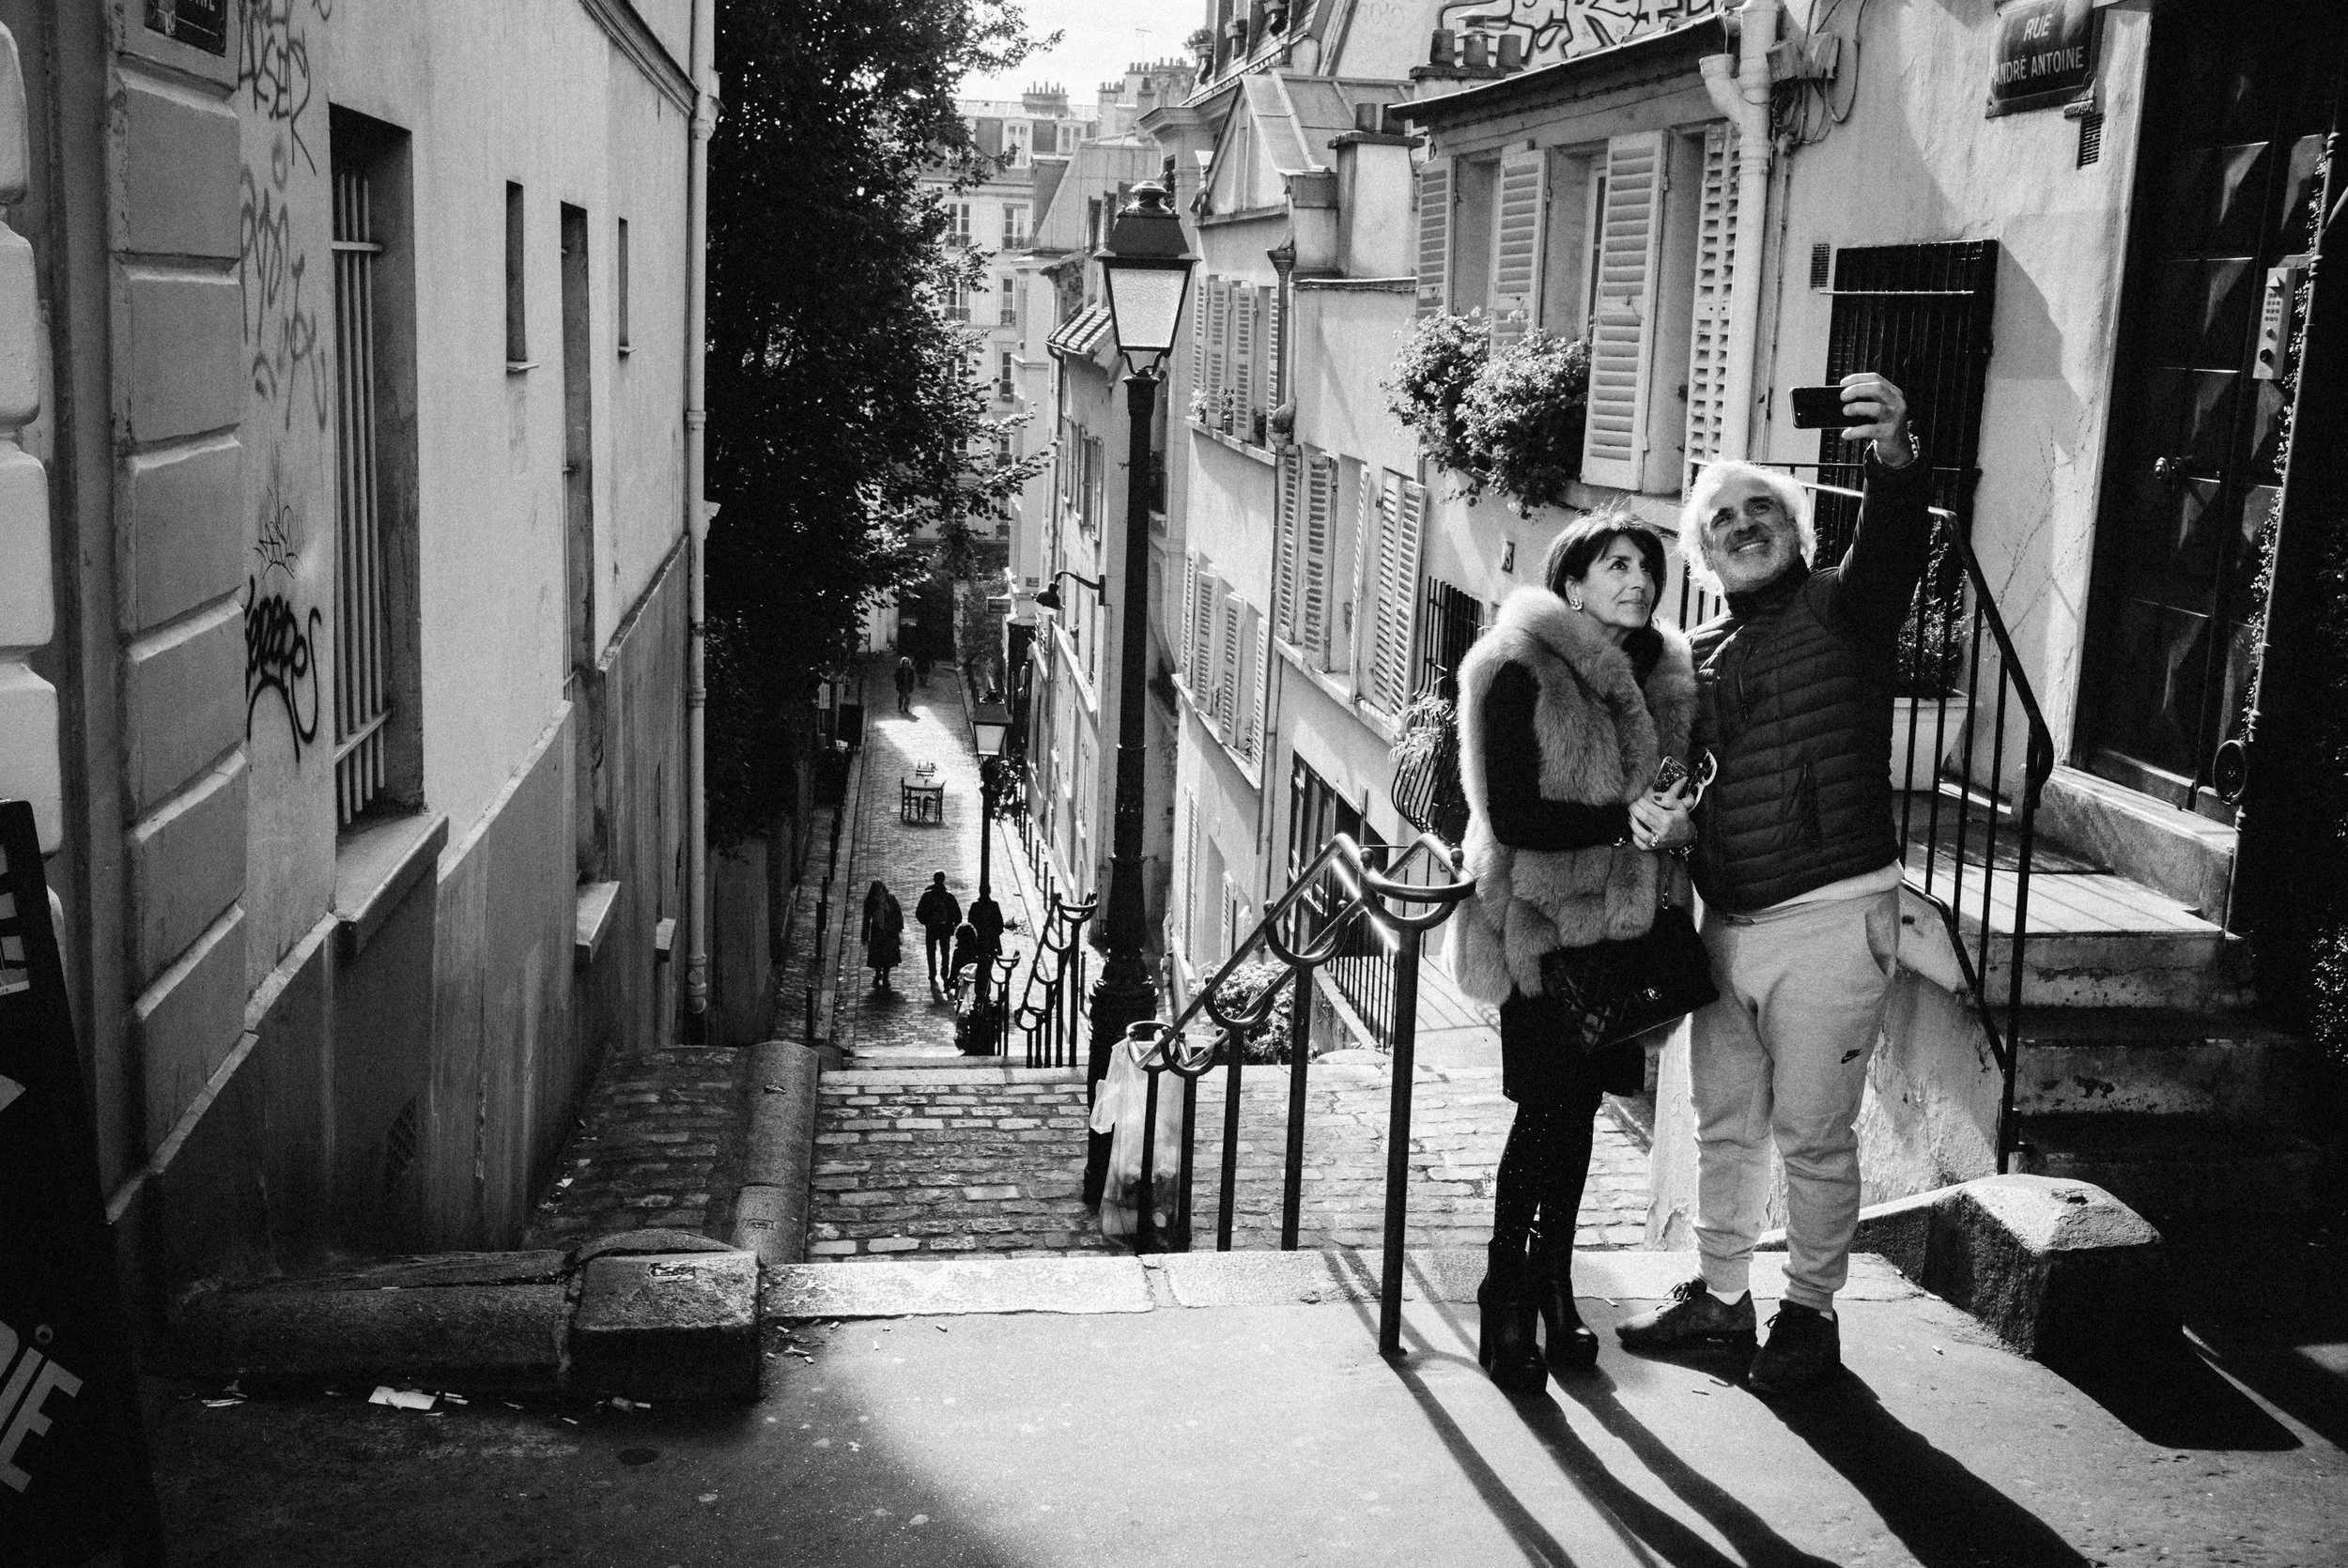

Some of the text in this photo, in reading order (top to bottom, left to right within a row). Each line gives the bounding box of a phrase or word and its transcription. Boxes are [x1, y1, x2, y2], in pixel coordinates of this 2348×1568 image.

[2023, 13, 2053, 41] RUE
[1993, 45, 2084, 85] ANDRÉ ANTOINE
